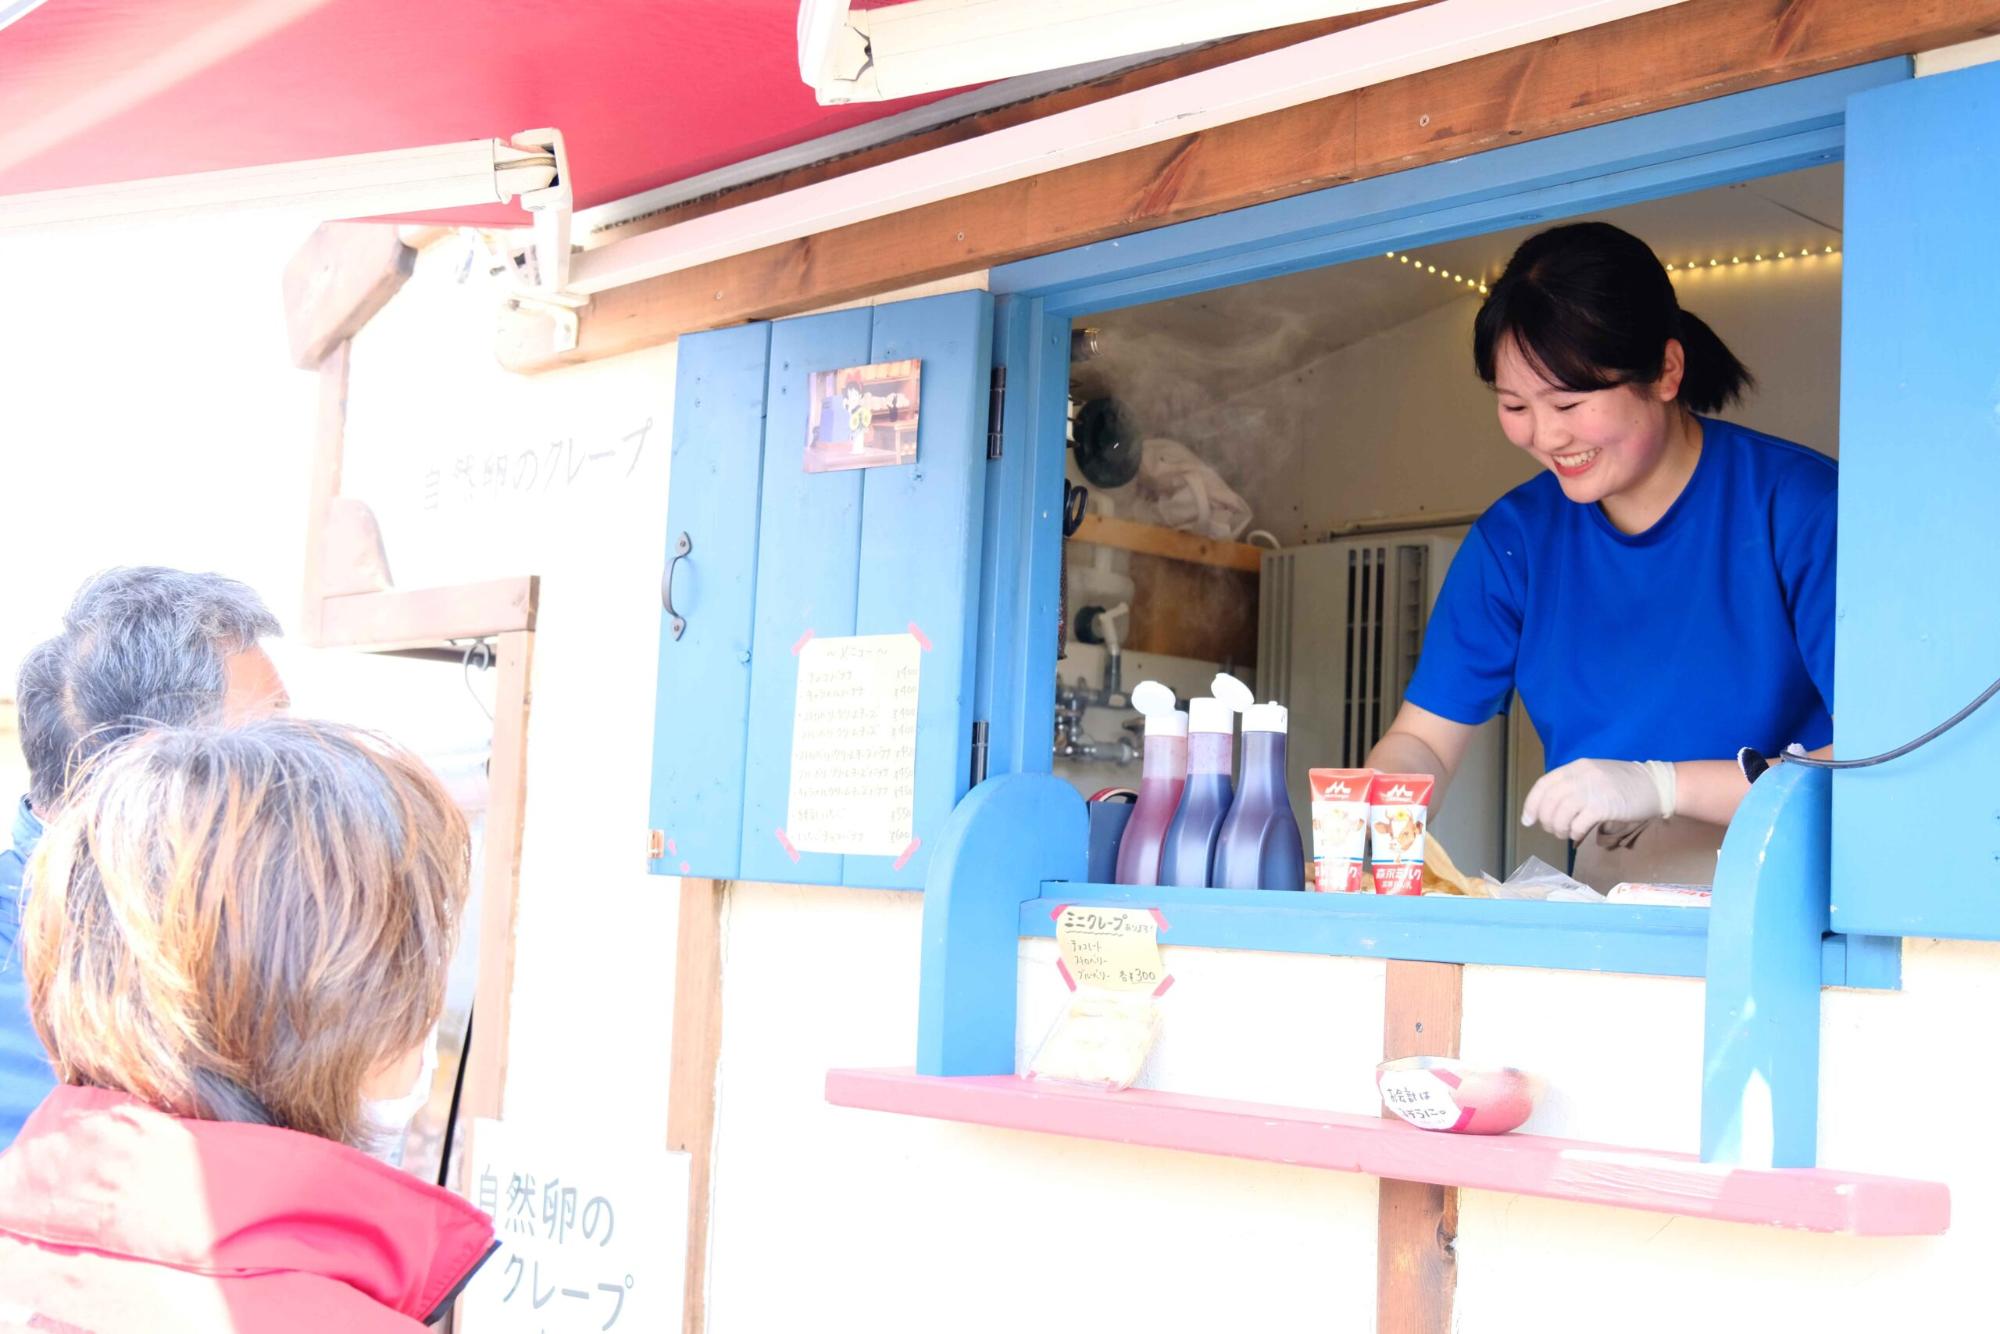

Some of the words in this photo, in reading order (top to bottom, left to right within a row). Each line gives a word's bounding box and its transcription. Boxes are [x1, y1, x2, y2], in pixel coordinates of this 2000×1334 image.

[423, 416, 654, 511] 自然卵のクレープ
[1064, 911, 1128, 931] ミニクレープ
[479, 1163, 615, 1247] 自然卵の
[503, 1253, 634, 1332] クレープ
